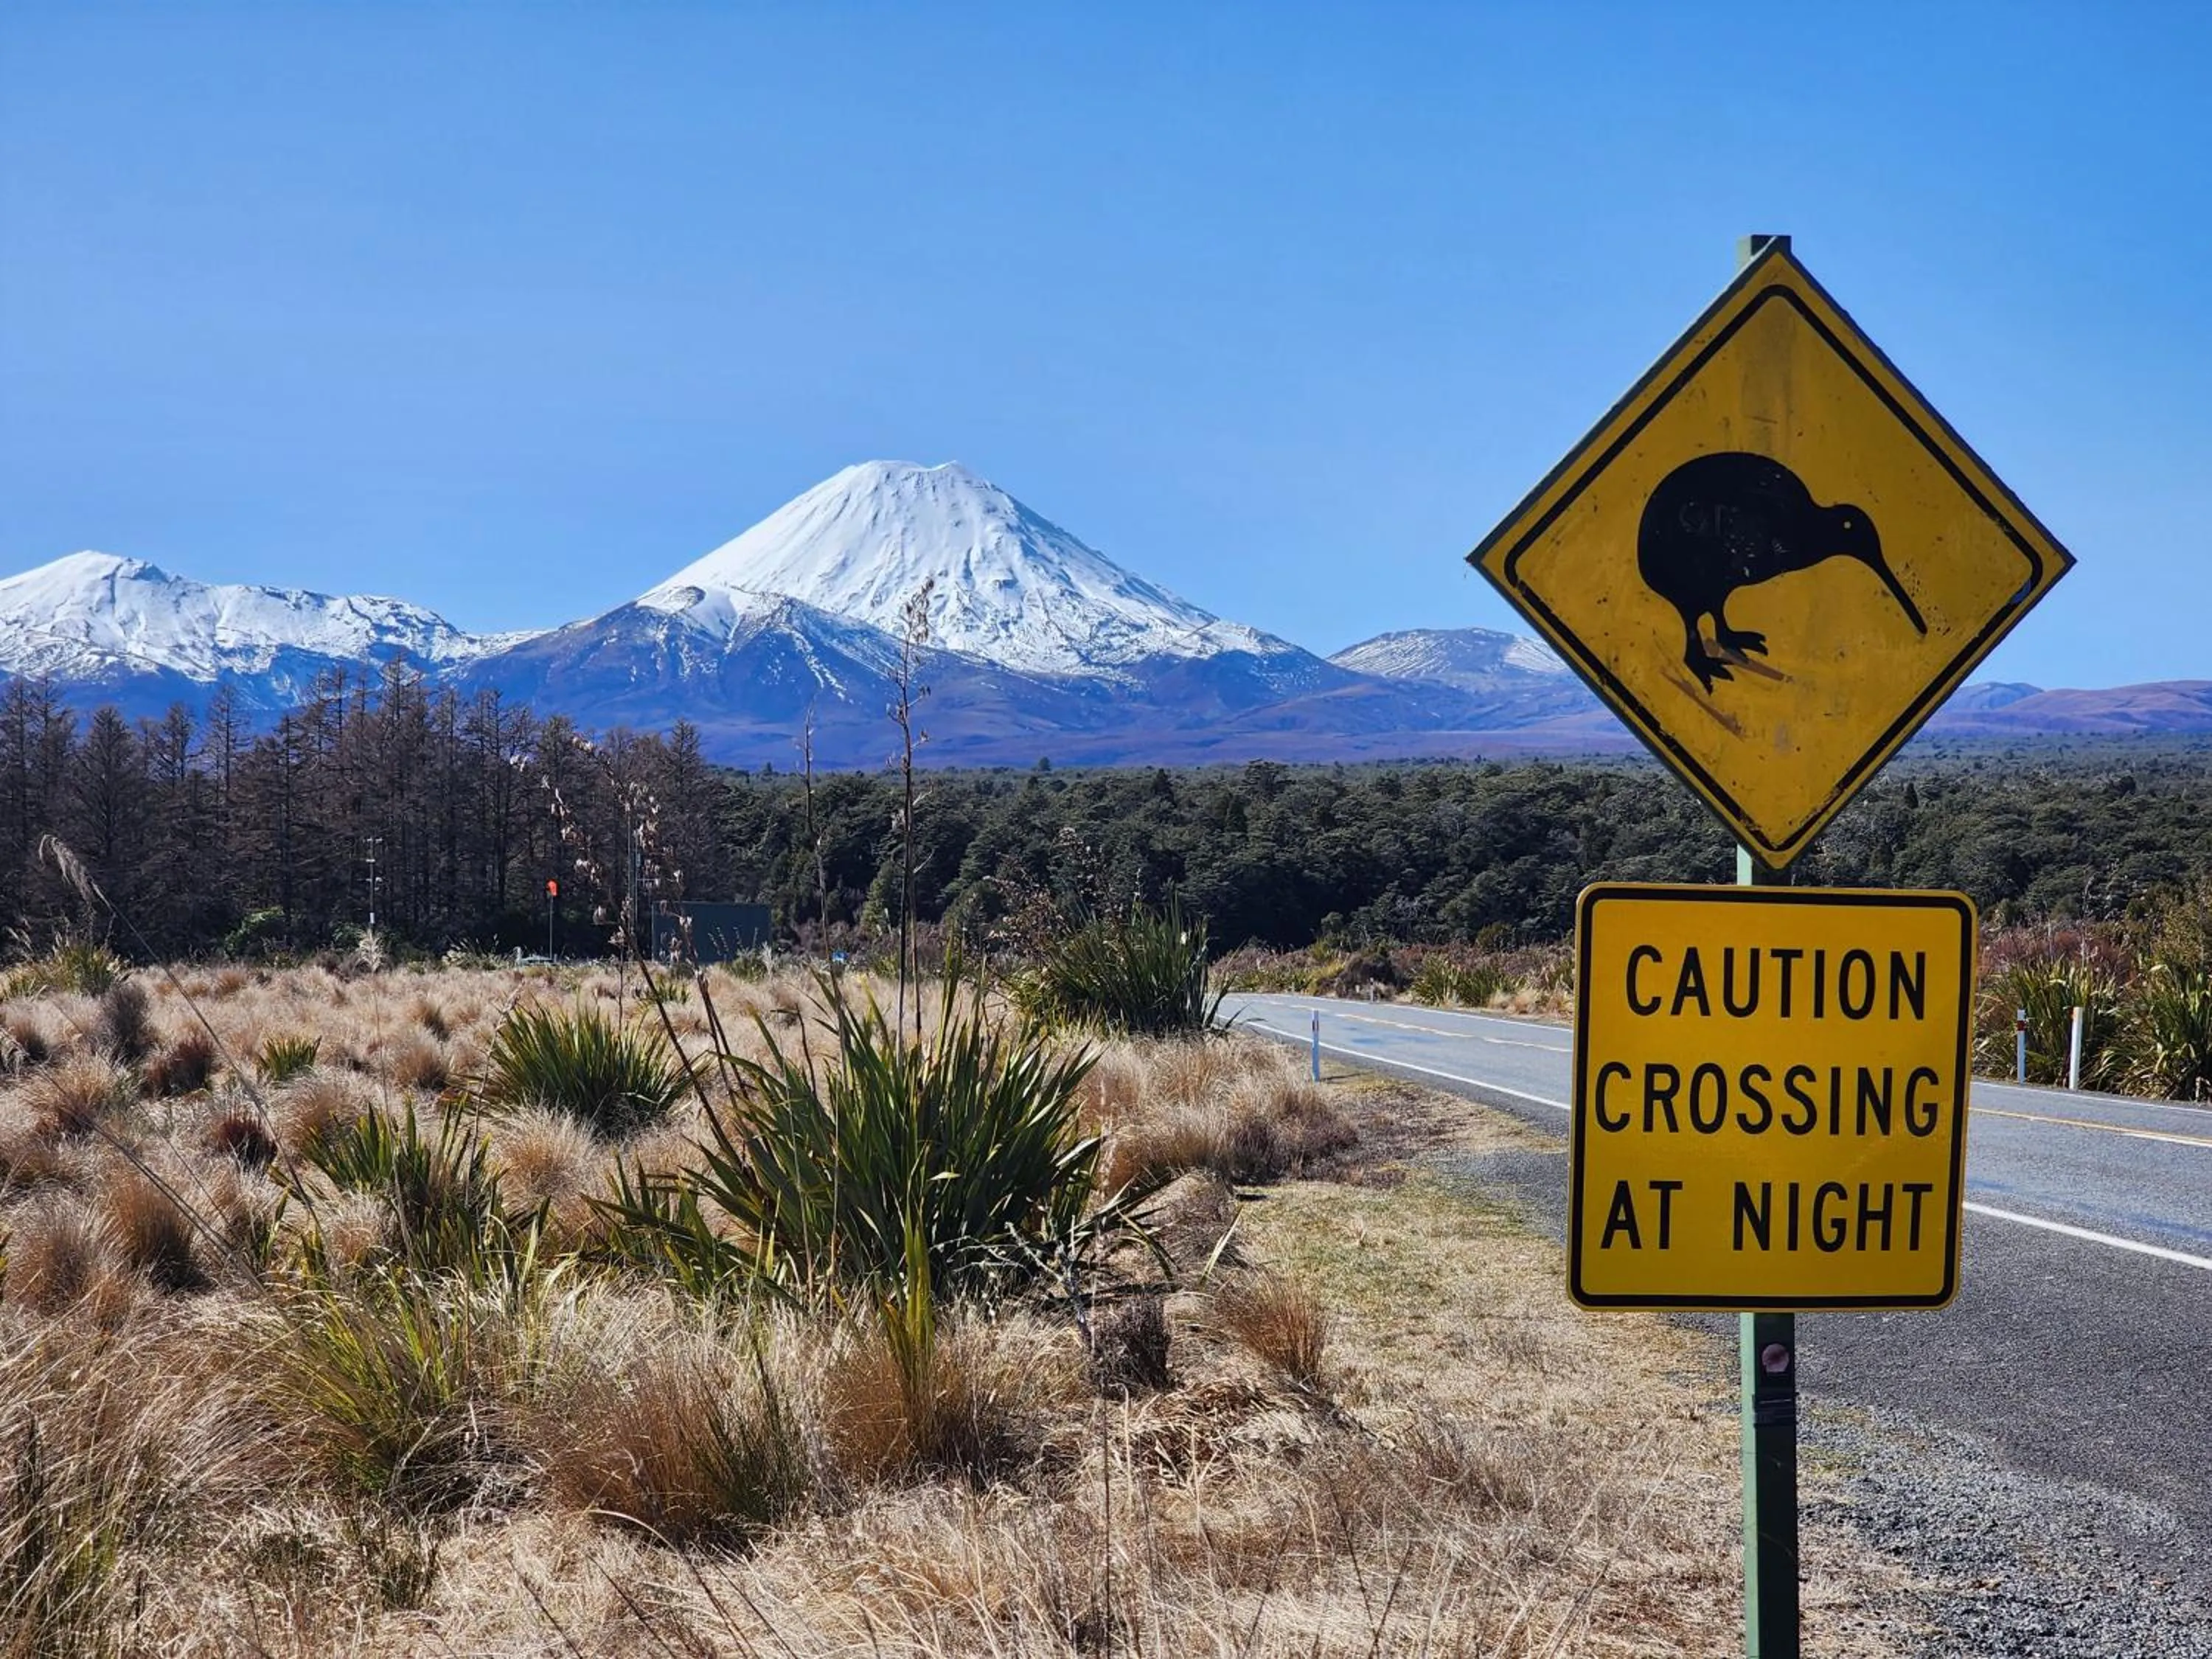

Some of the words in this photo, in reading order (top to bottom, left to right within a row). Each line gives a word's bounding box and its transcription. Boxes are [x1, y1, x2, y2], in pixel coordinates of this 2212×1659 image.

[1626, 945, 1926, 1020] CAUTION
[1595, 1061, 1939, 1138] CROSSING
[1600, 1180, 1683, 1250] AT
[1733, 1181, 1934, 1253] NIGHT
